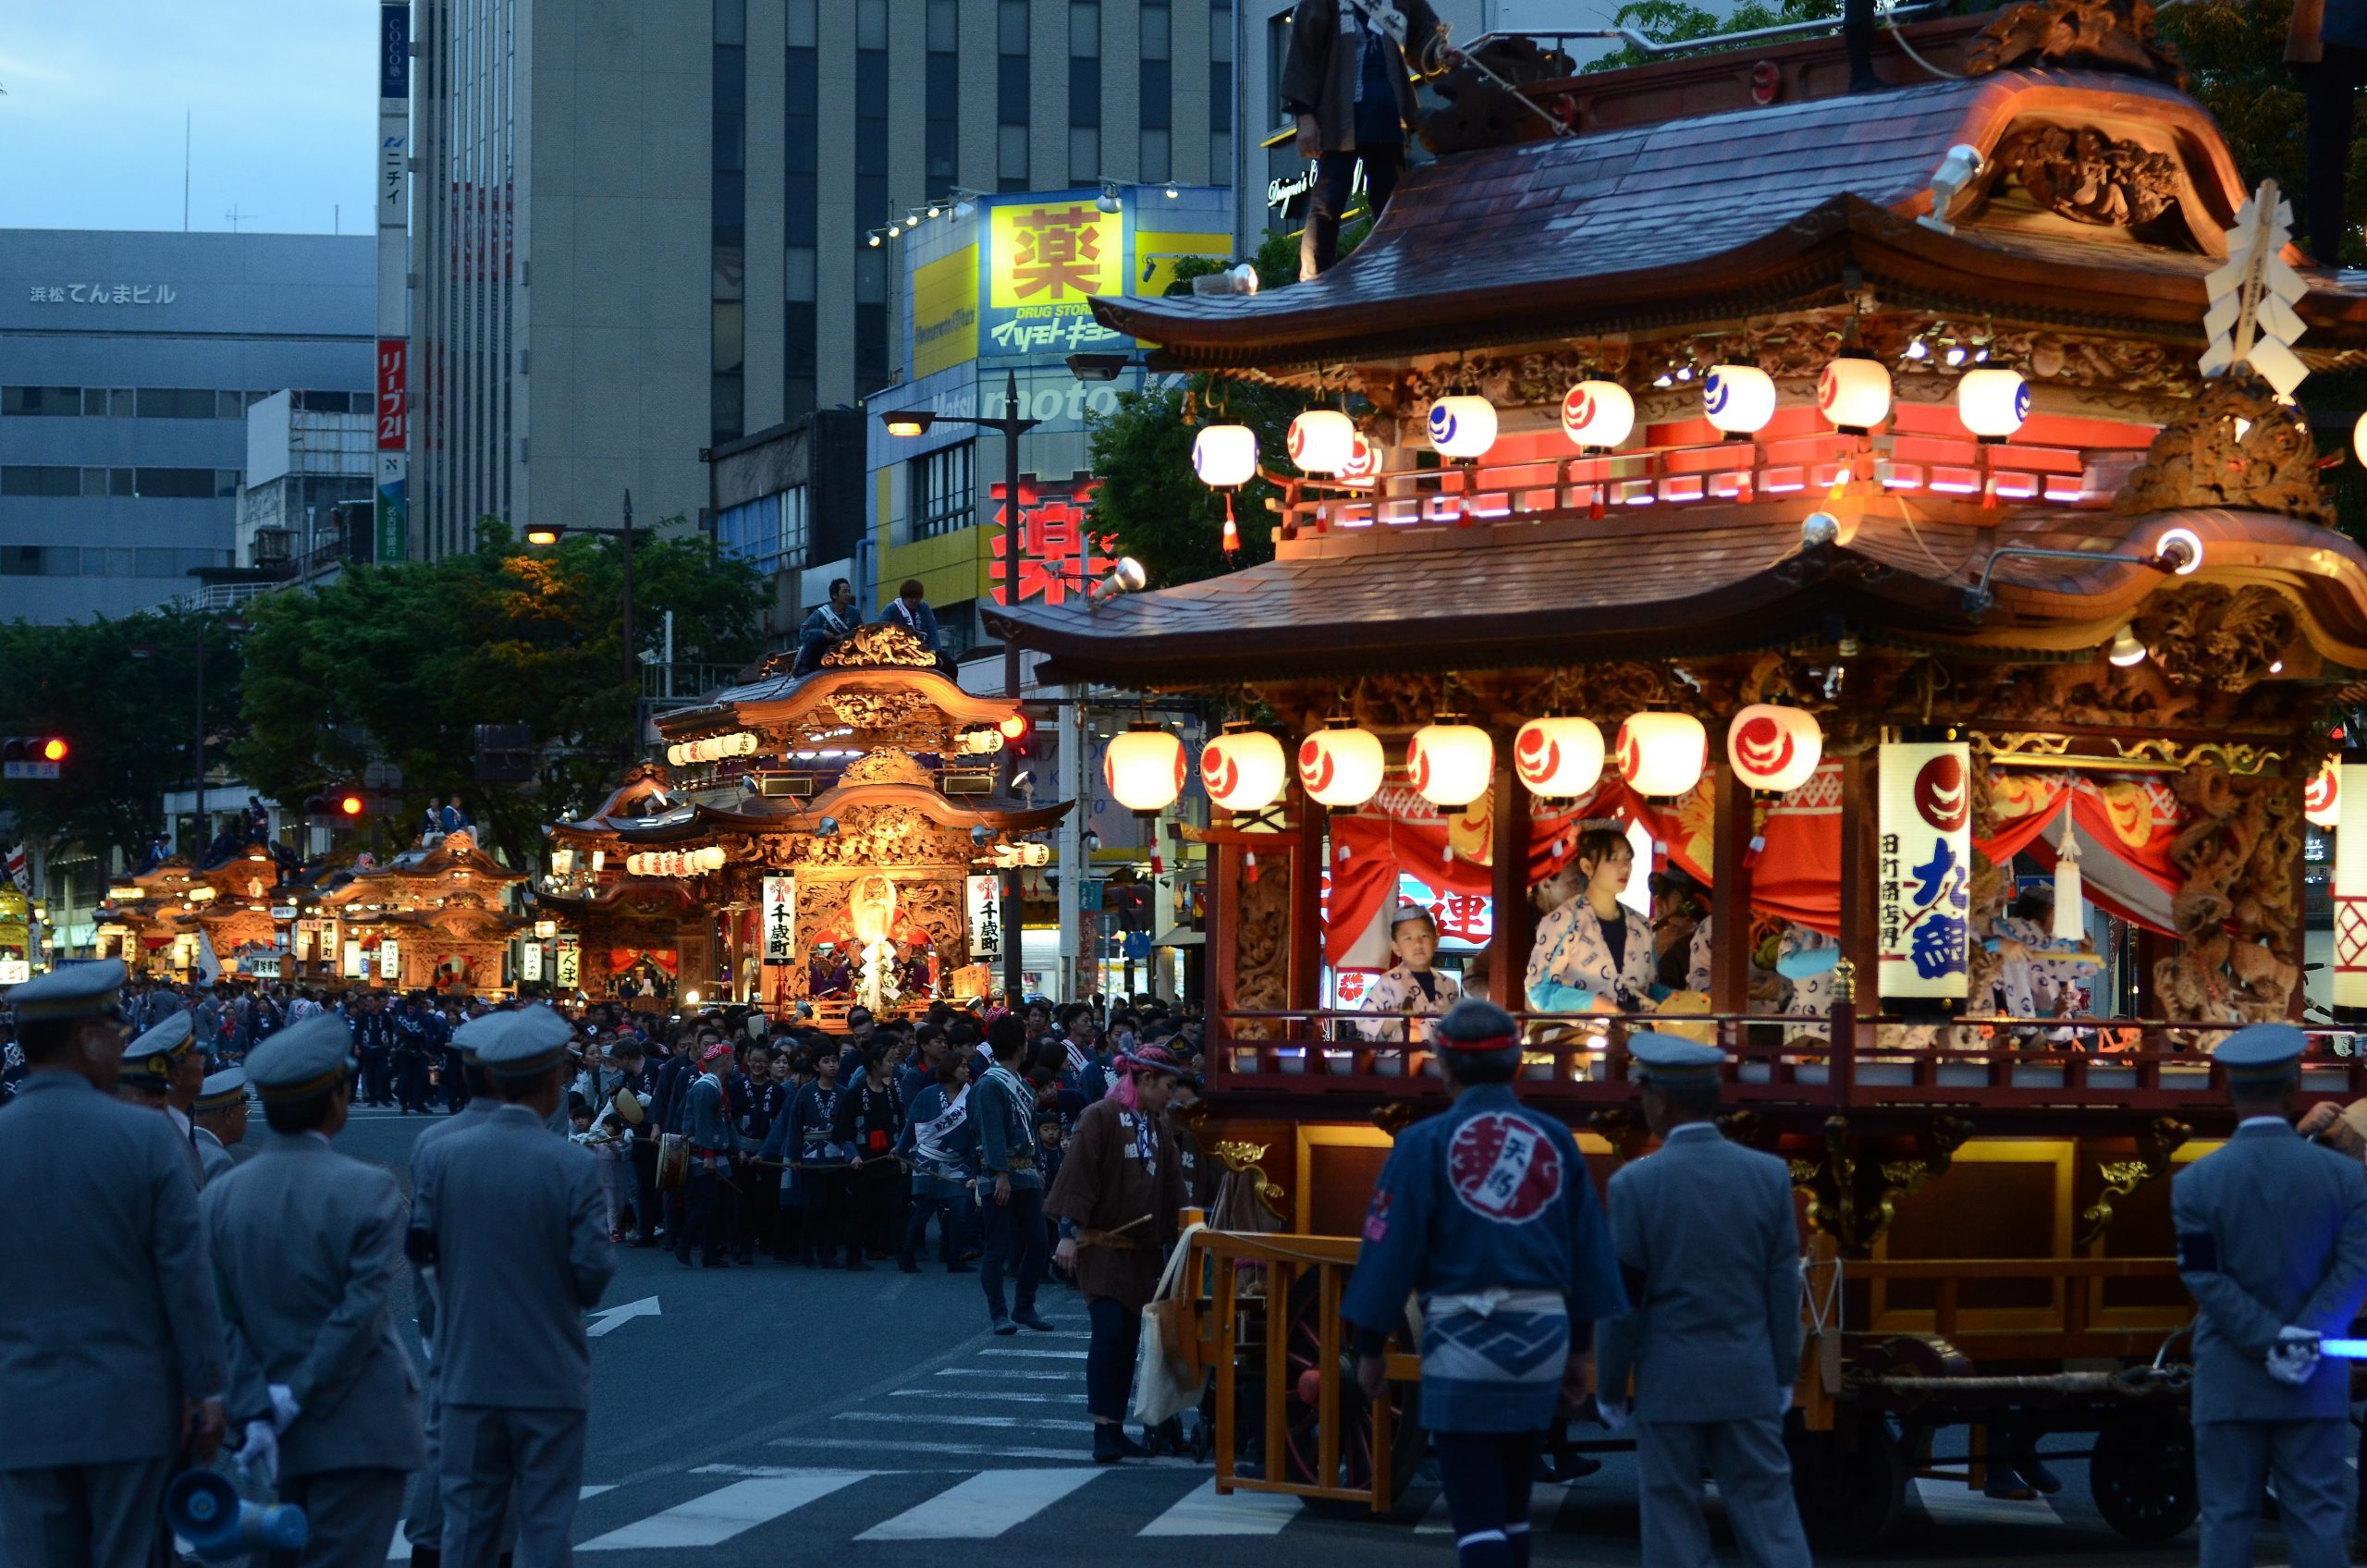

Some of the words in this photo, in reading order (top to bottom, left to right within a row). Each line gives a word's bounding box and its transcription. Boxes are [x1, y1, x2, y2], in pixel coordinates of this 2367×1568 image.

[1012, 206, 1101, 300] 薬
[30, 284, 177, 305] 浜松てんまビル
[1015, 305, 1052, 319] DRUG
[380, 350, 404, 440] リーブ21
[989, 471, 1120, 606] 薬
[770, 903, 791, 957] 千歳町
[979, 900, 999, 953] 千歳町
[562, 938, 578, 983] てんま
